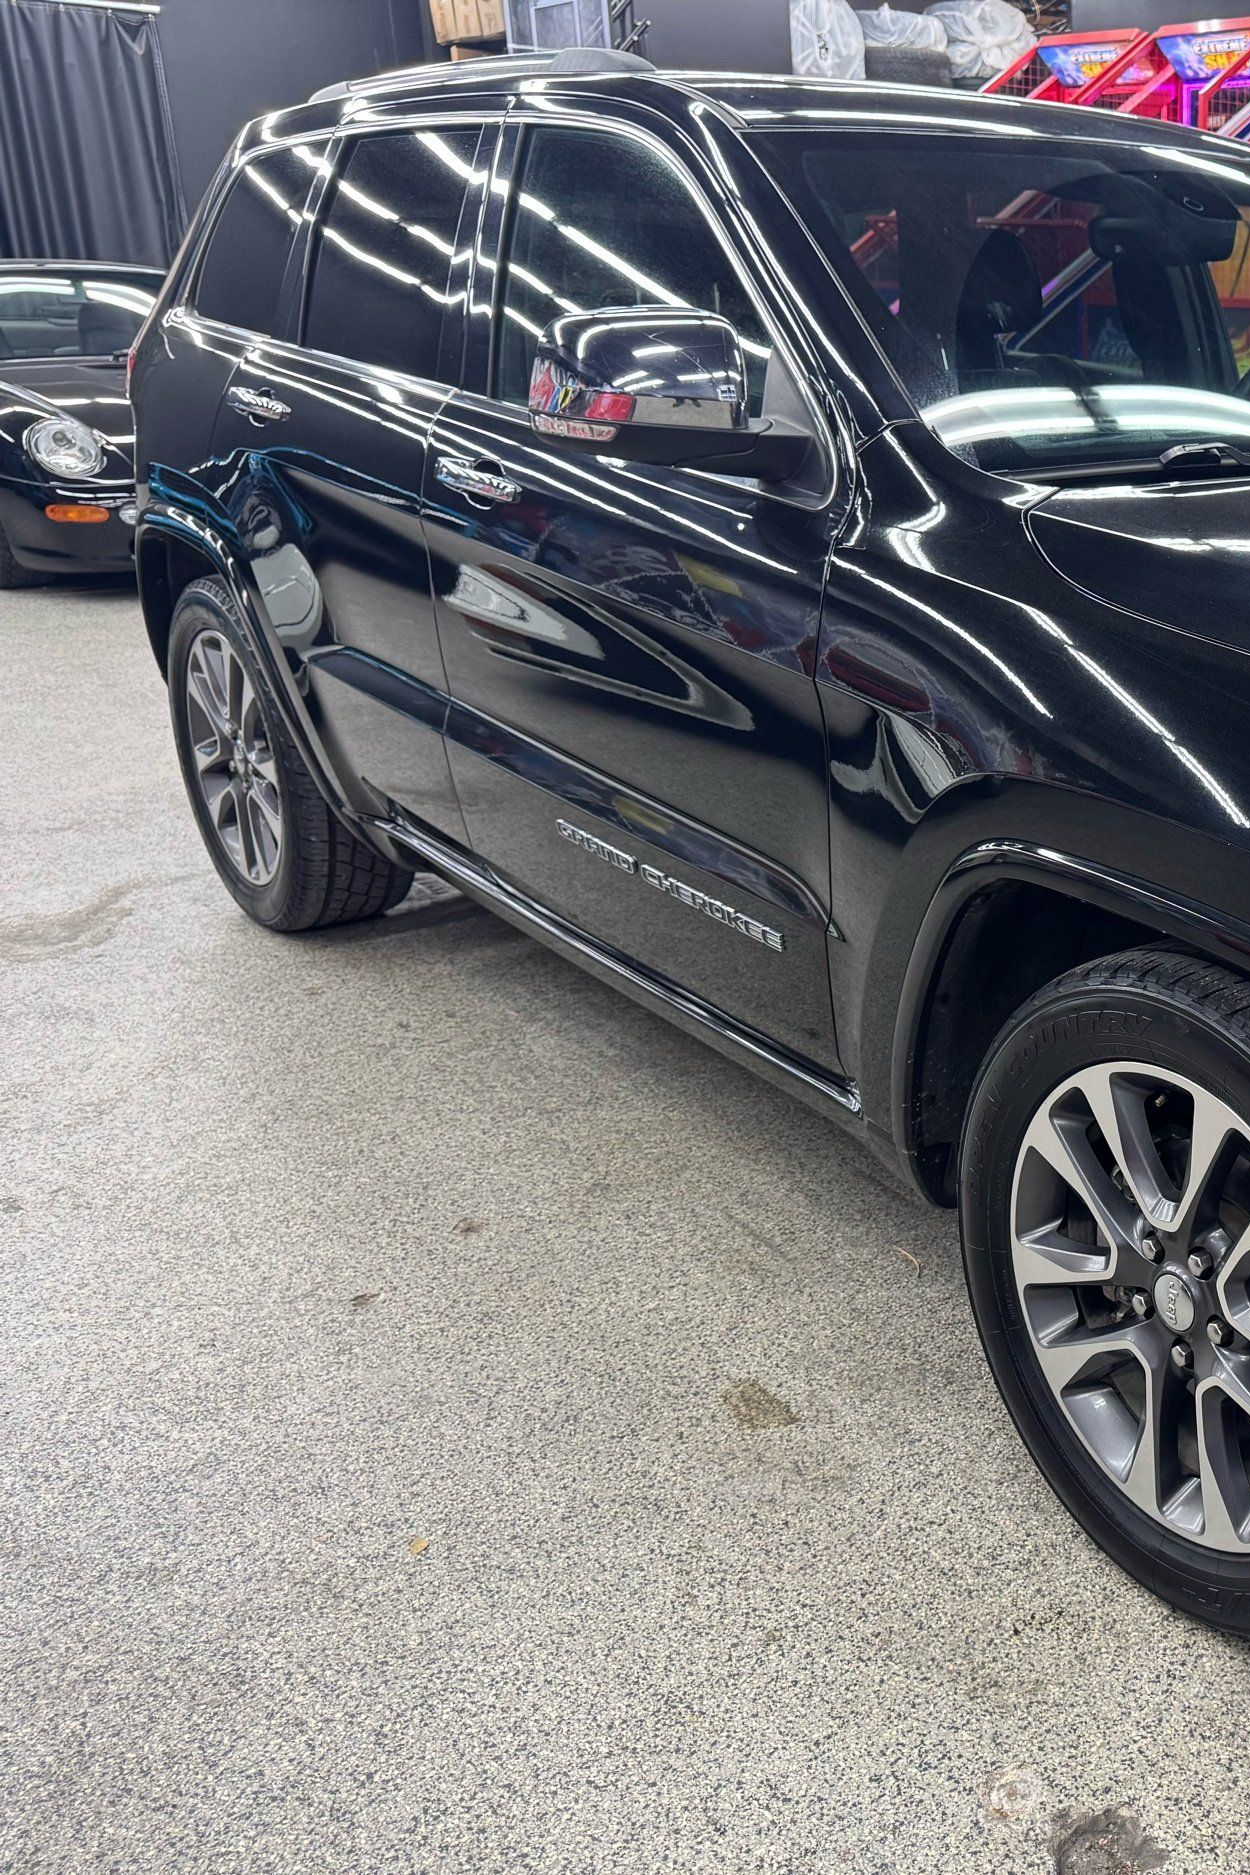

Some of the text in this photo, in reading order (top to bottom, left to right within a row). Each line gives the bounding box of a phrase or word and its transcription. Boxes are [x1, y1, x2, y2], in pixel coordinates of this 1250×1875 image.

[556, 818, 785, 952] GRAND CHEROKEE
[1009, 1009, 1154, 1078] COUNTRY
[1165, 1281, 1179, 1325] Jeep
